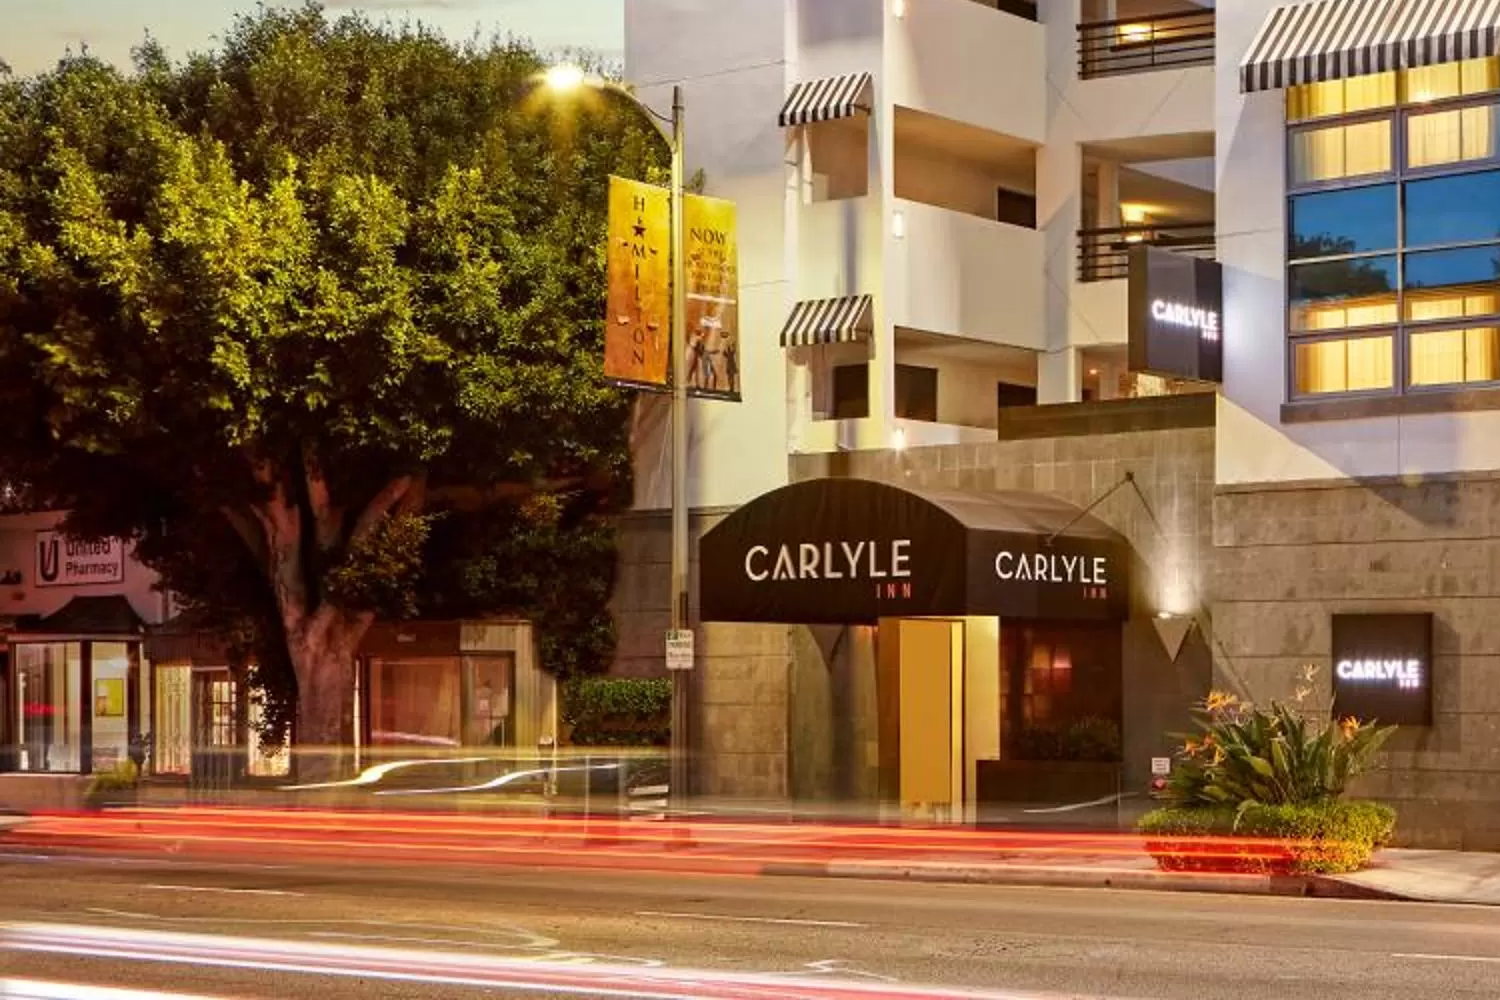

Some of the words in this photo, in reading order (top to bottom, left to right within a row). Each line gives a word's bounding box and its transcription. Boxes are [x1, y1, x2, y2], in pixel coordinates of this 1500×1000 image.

[690, 227, 727, 245] NOW
[1151, 299, 1217, 330] CARLYLE
[65, 561, 118, 577] Pharmacy
[745, 540, 911, 581] CARLYLE
[995, 551, 1107, 584] CARLYLE
[876, 583, 911, 599] INN
[1337, 660, 1420, 679] CARLYLE
